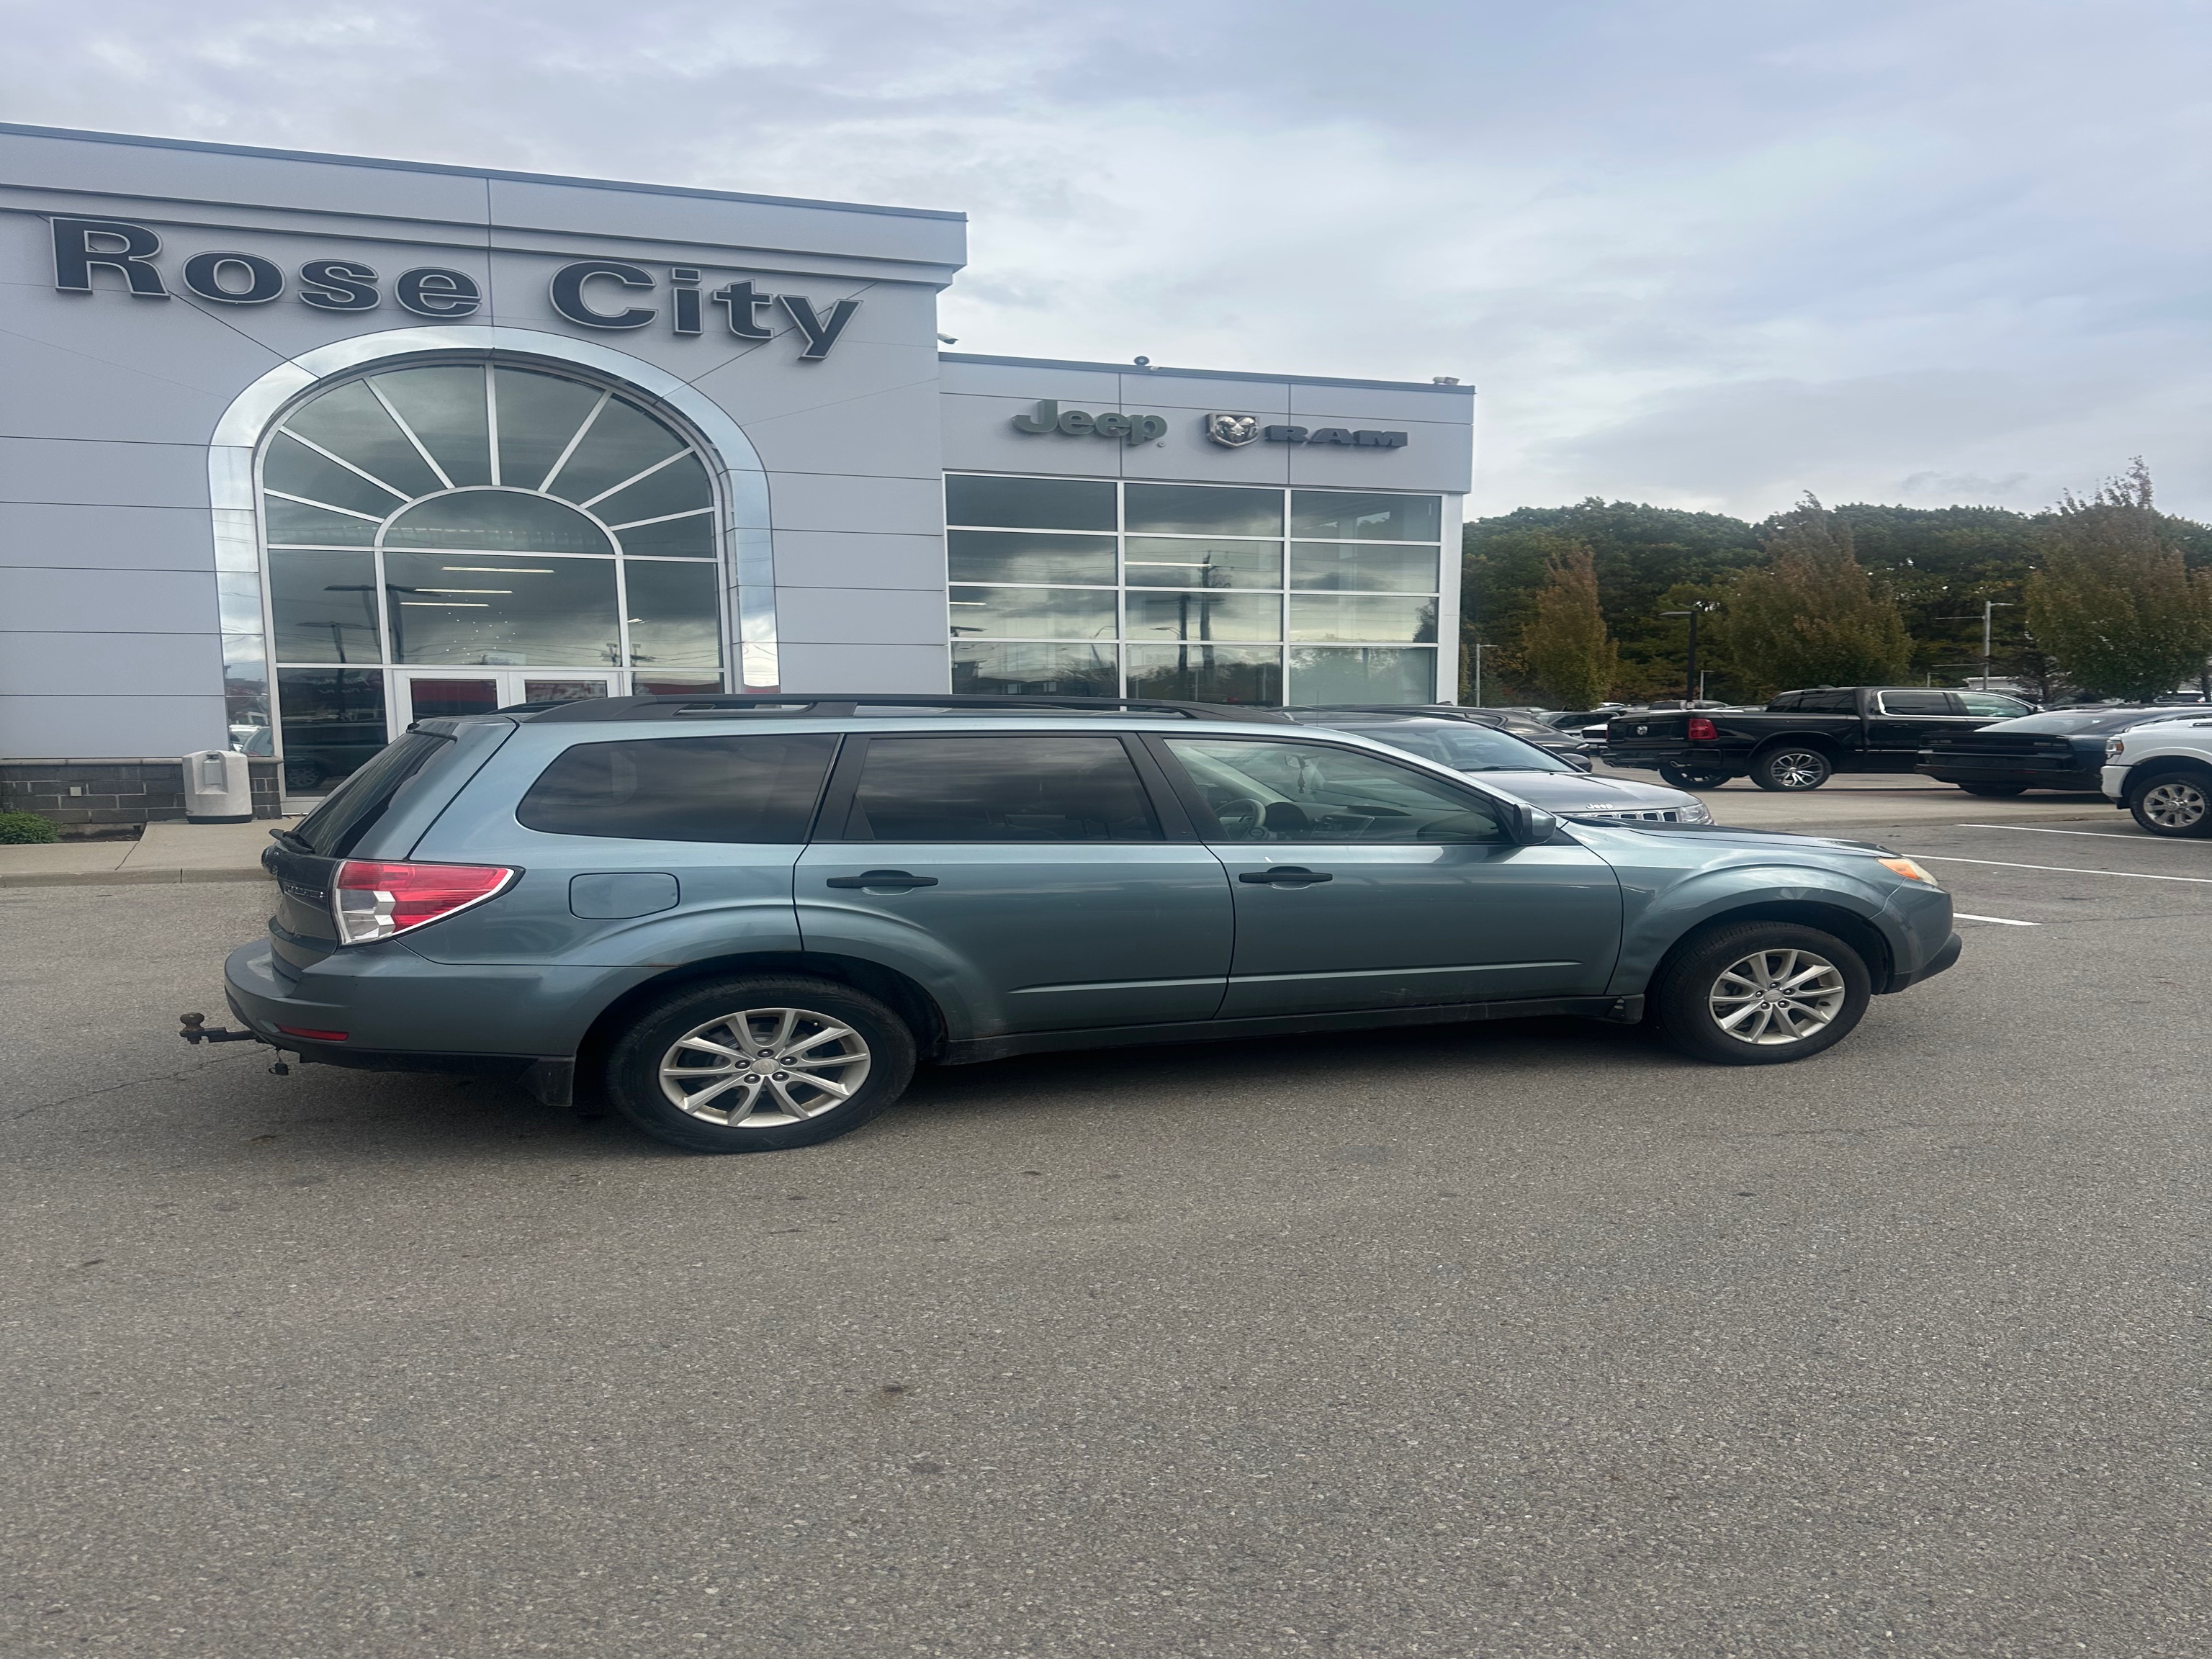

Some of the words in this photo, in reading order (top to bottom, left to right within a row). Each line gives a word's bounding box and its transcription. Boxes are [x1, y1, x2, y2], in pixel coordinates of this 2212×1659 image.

[48, 216, 482, 318] Rose
[549, 260, 864, 359] City
[1012, 399, 1168, 446] Jeep
[1265, 425, 1408, 447] RAM
